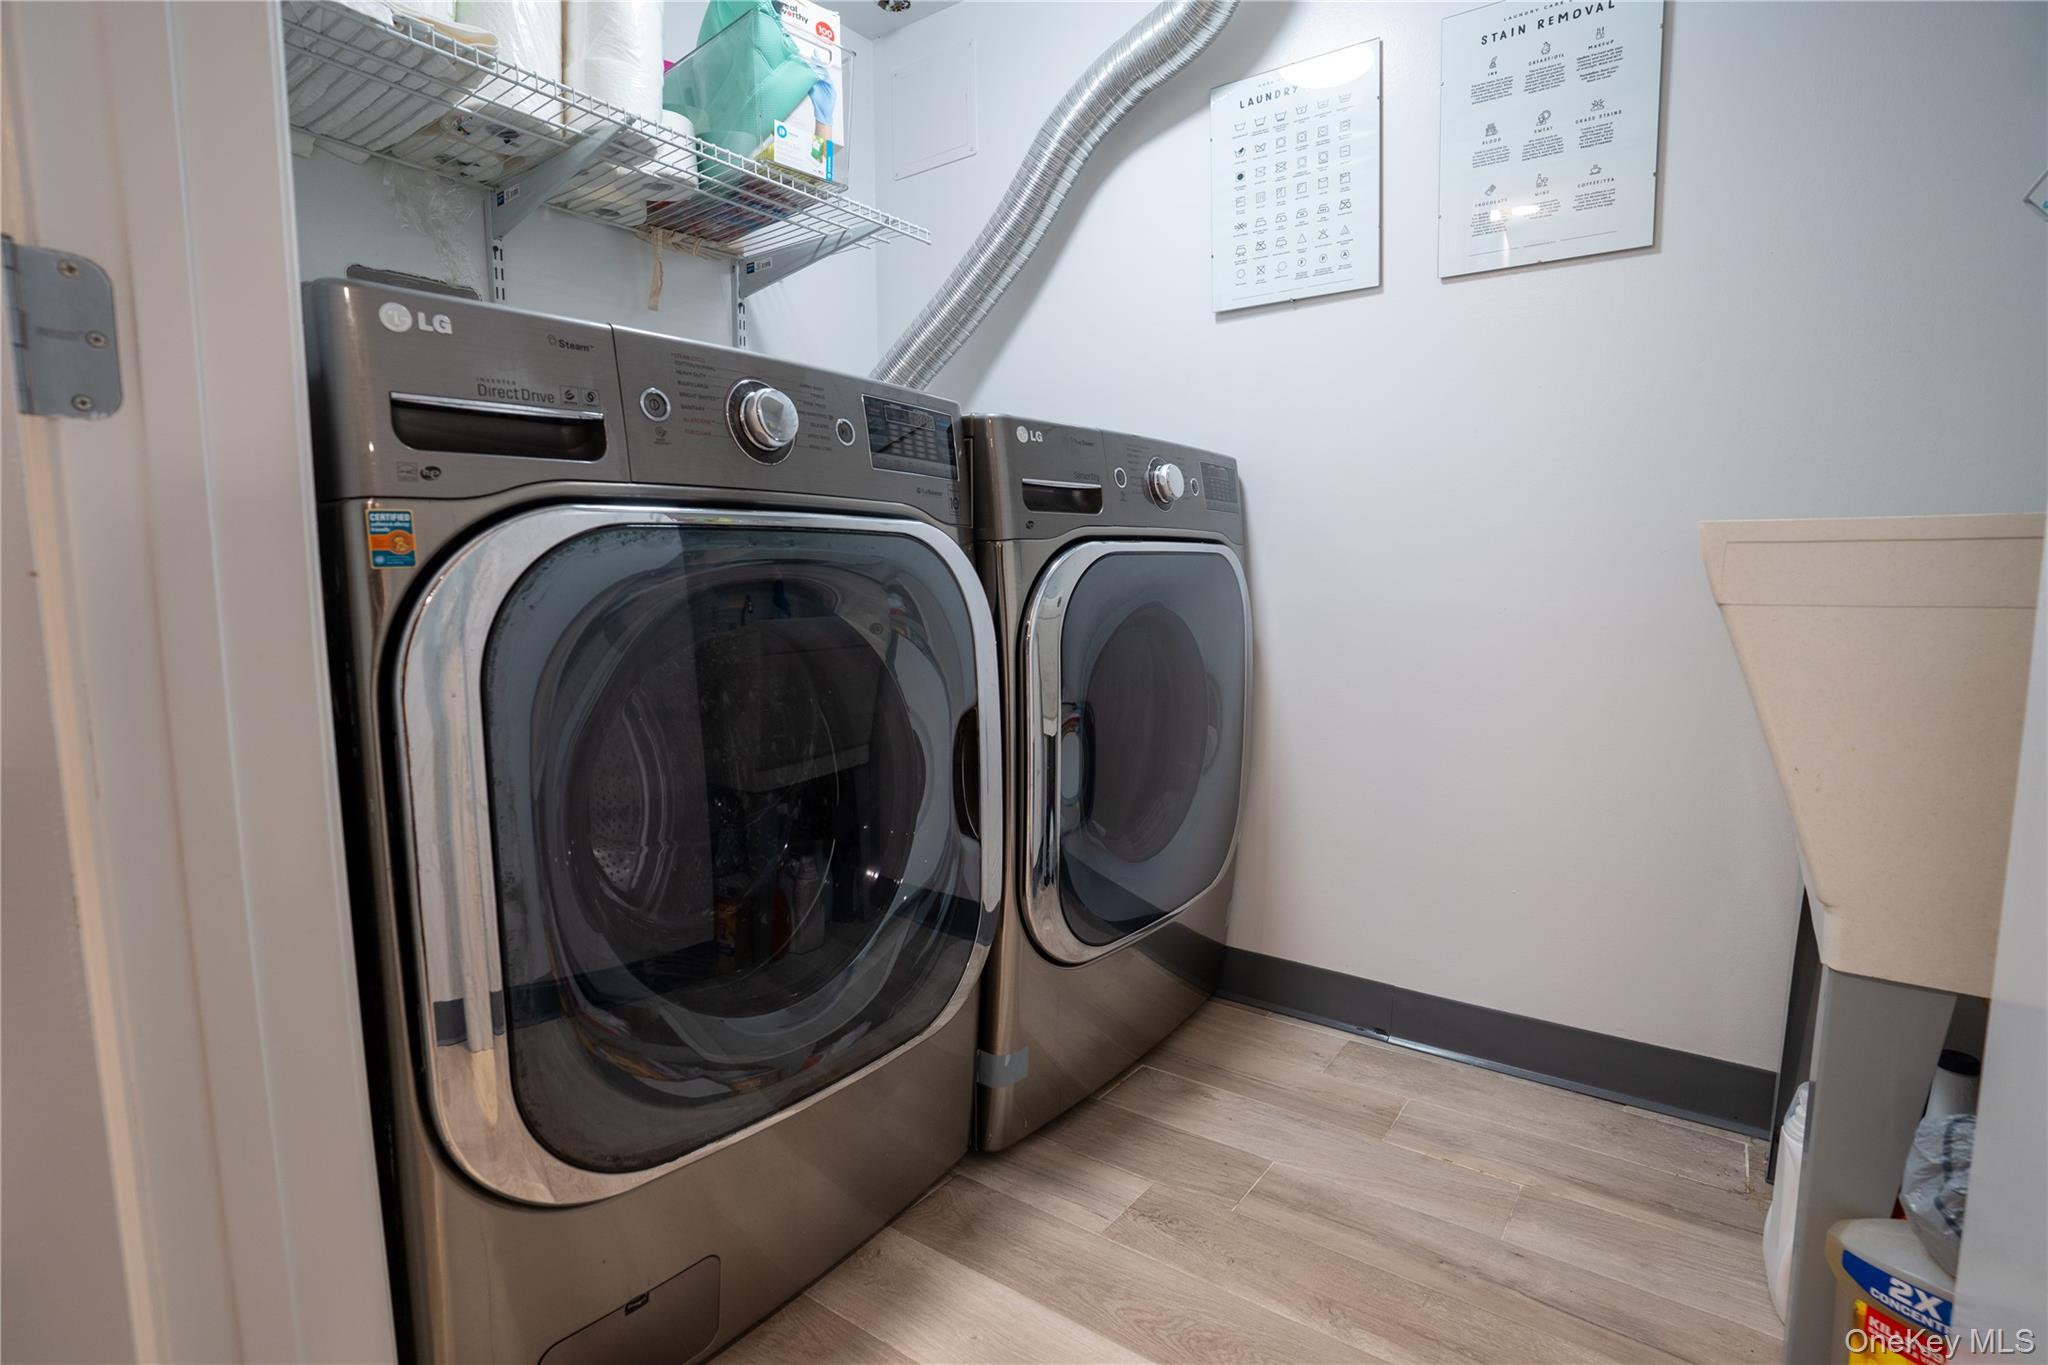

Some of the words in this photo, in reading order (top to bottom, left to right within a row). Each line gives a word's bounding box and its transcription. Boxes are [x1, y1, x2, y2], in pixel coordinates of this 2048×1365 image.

[1481, 24, 1526, 45] STAIN
[1537, 0, 1615, 30] REMOVAL
[1240, 85, 1298, 109] LAUNDRY
[417, 311, 453, 335] LG
[477, 383, 519, 400] Direct
[521, 388, 555, 404] Drive
[1029, 430, 1044, 442] LG
[369, 513, 411, 522] CERTIFIED
[1889, 1277, 1945, 1322] 2X
